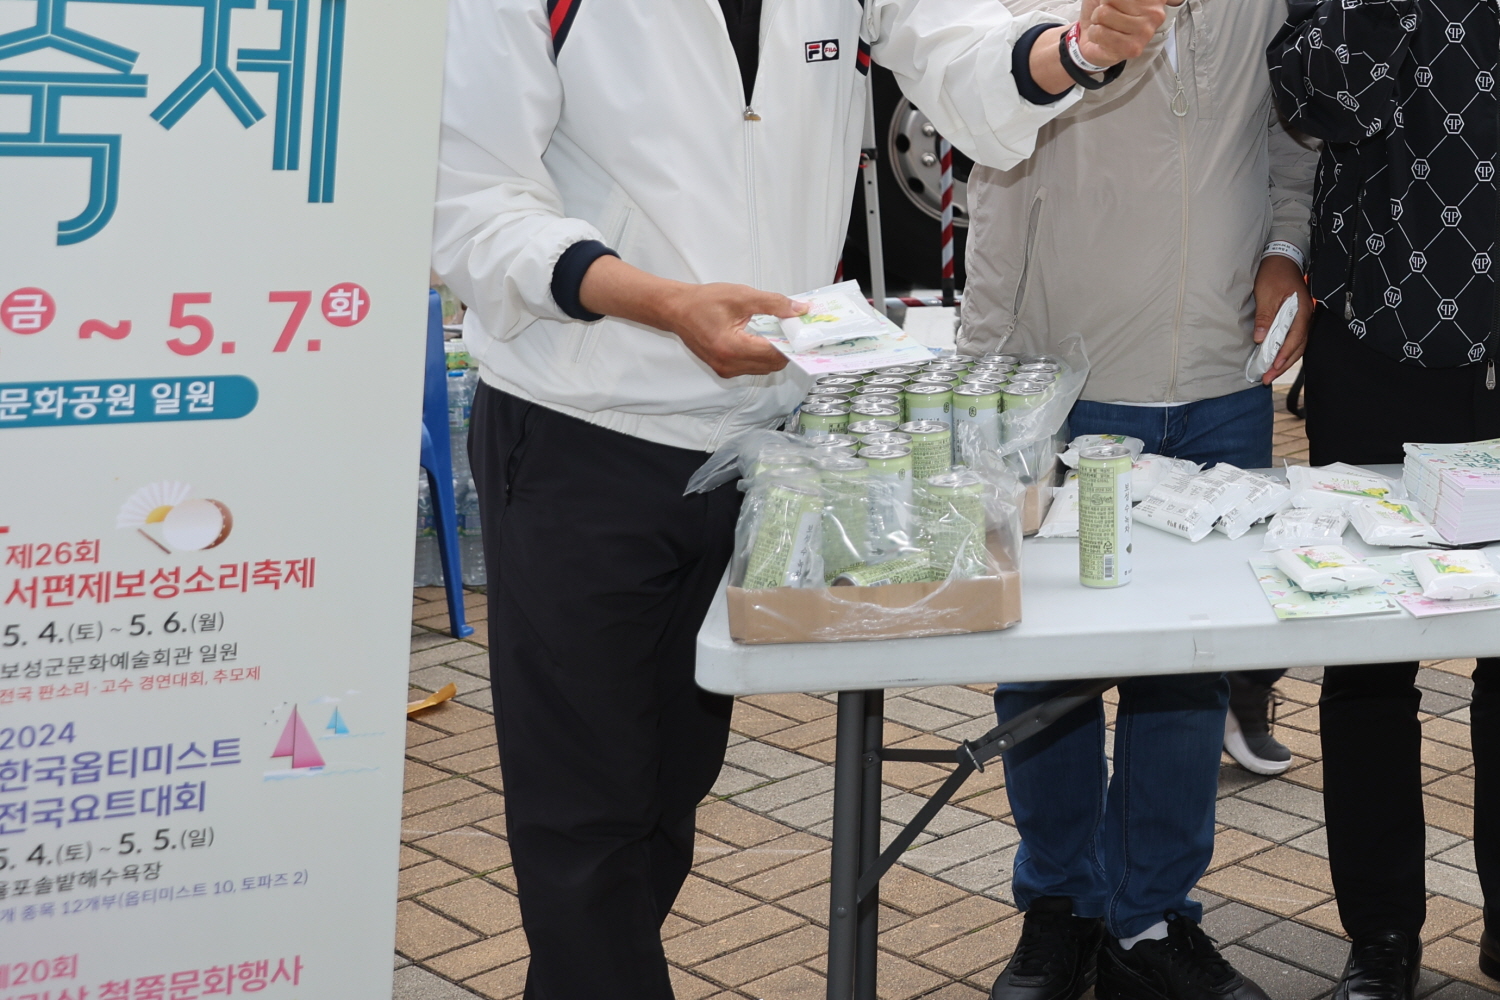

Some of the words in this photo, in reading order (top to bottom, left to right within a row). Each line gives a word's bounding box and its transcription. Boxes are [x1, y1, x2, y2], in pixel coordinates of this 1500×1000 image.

[8, 294, 48, 329] 금
[328, 288, 364, 322] 화
[0, 383, 136, 421] 문화공원
[151, 380, 215, 415] 일원
[5, 538, 101, 570] 제26회
[5, 556, 317, 609] 서편제보성소리축제
[0, 646, 194, 681] 보성군문화예술회관
[199, 641, 239, 664] 일원
[213, 665, 261, 685] 추모제
[0, 721, 77, 751] 2024
[0, 737, 243, 794] 한국옵티미스트
[0, 780, 207, 836] 전국요트대회
[241, 873, 289, 891] 토파즈
